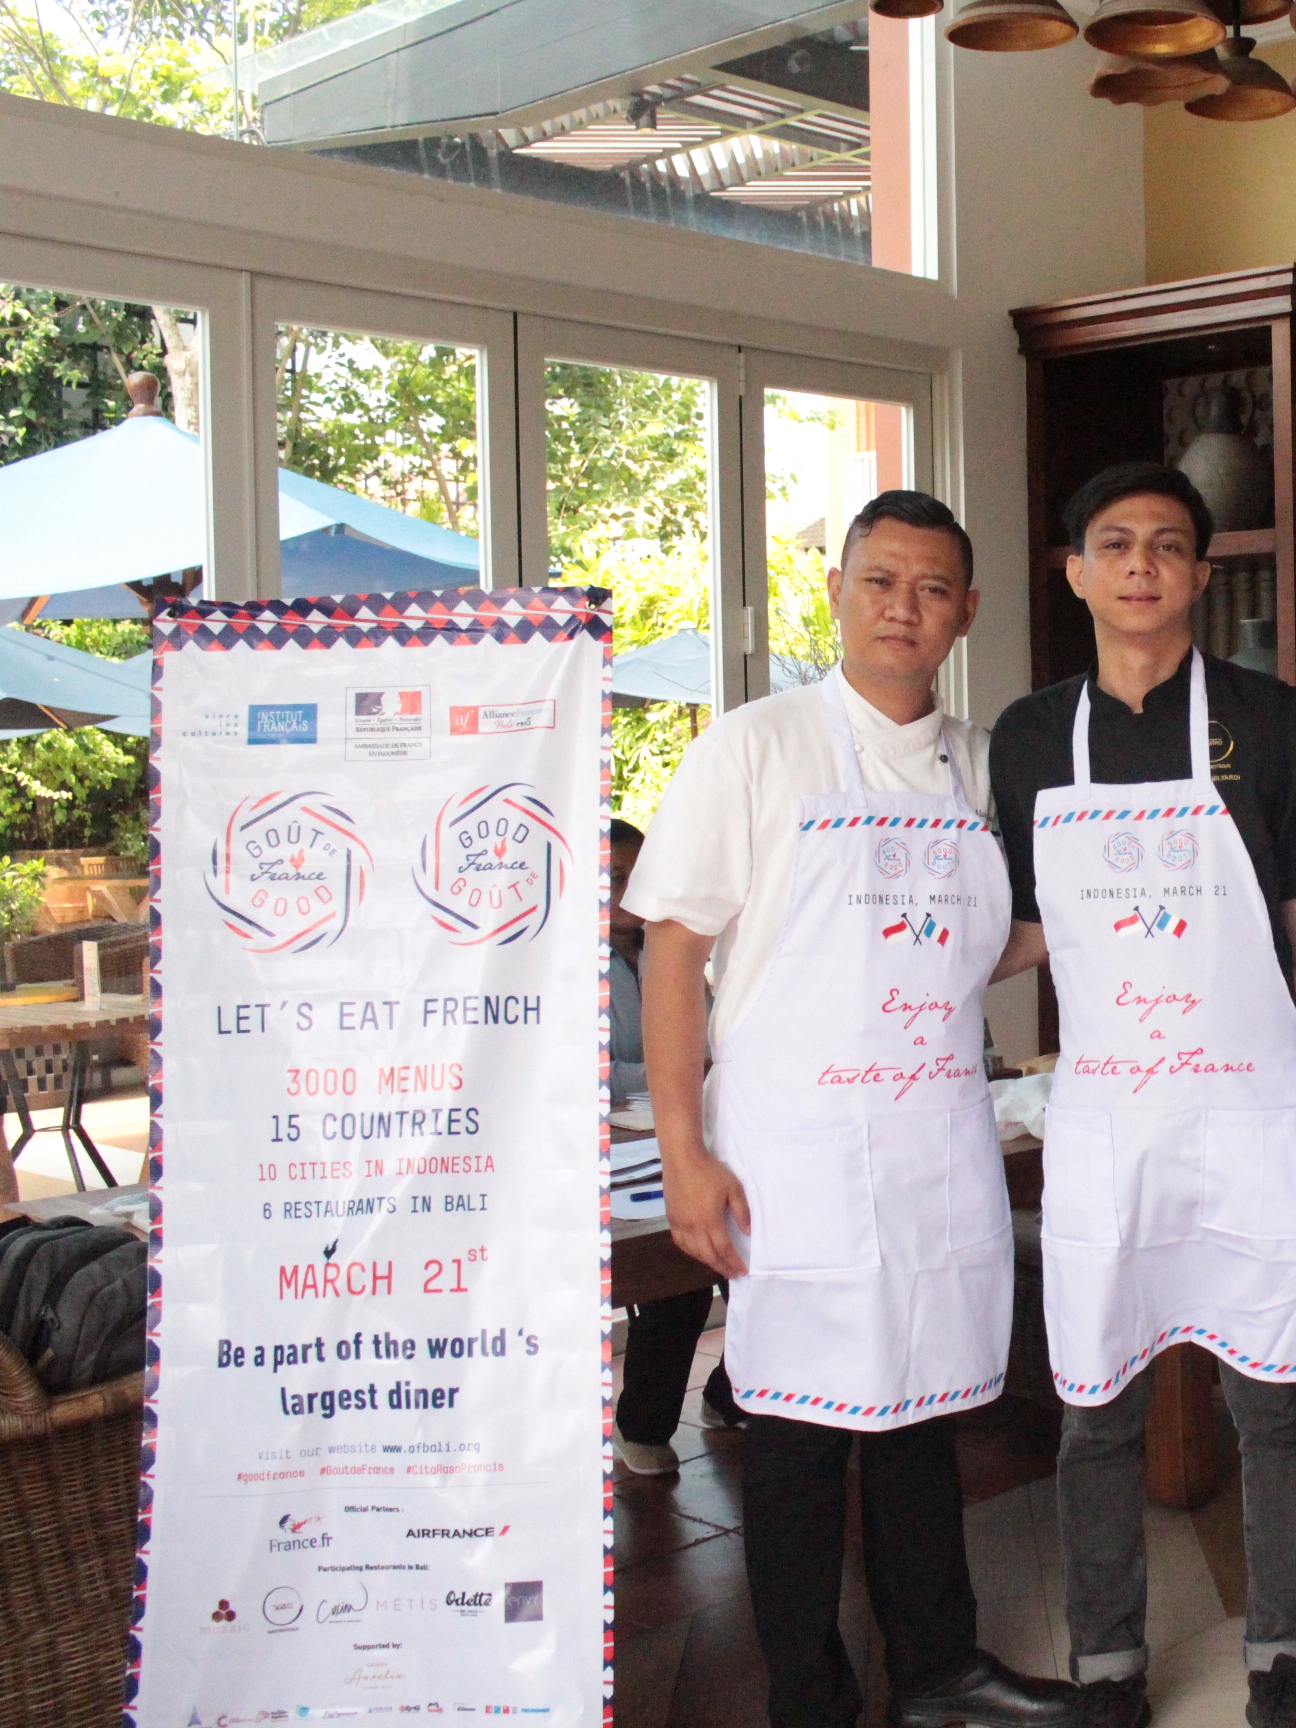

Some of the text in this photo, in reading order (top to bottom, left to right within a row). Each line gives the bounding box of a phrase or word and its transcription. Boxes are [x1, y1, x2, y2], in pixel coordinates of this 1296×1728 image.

[257, 710, 303, 721] INSTITUT
[257, 720, 309, 733] FRANÇAIS
[245, 820, 324, 859] GOÛT
[458, 817, 531, 849] GOOD
[250, 859, 327, 882] France
[458, 850, 530, 873] France
[251, 883, 333, 918] GOOD
[450, 876, 524, 910] GOÛT
[847, 894, 978, 907] INDONESIA, MARCH 21
[1080, 885, 1227, 900] INDONESIA, MARCH 21
[882, 988, 957, 1029] Enjoy
[1115, 981, 1203, 1023] Enjoy
[216, 995, 542, 1035] LET'S EAT FRENCH
[913, 1035, 928, 1046] a
[1150, 1029, 1166, 1039] a
[285, 1063, 464, 1097] 3000 MENUS
[818, 1062, 899, 1085] taste
[892, 1062, 926, 1101] of
[1074, 1047, 1256, 1095] taste of France
[270, 1107, 480, 1143] 15 COUNTRIES
[258, 1155, 495, 1182] 10 CITIES IN INDONESIA
[263, 1193, 488, 1220] 6 RESTAURANTS IN BALI
[279, 1260, 392, 1301] MARCH
[217, 1338, 245, 1368] Be
[253, 1345, 265, 1367] a
[273, 1336, 326, 1373] part
[336, 1332, 364, 1361] of
[372, 1331, 416, 1360] the
[427, 1328, 507, 1359] world
[280, 1381, 460, 1419] largest diner
[258, 1441, 481, 1461] visit our website www.afbali.org
[237, 1461, 505, 1484] #goodfrance #GoutdeFrance #CitaRasaPrancis
[344, 1504, 369, 1513] Official
[269, 1532, 333, 1553] France.fr
[406, 1526, 495, 1539] AIRFRANCE
[317, 1564, 363, 1573] Participating
[365, 1563, 406, 1572] Restaurants
[445, 1590, 493, 1607] Odette
[353, 1643, 390, 1651] Supported
